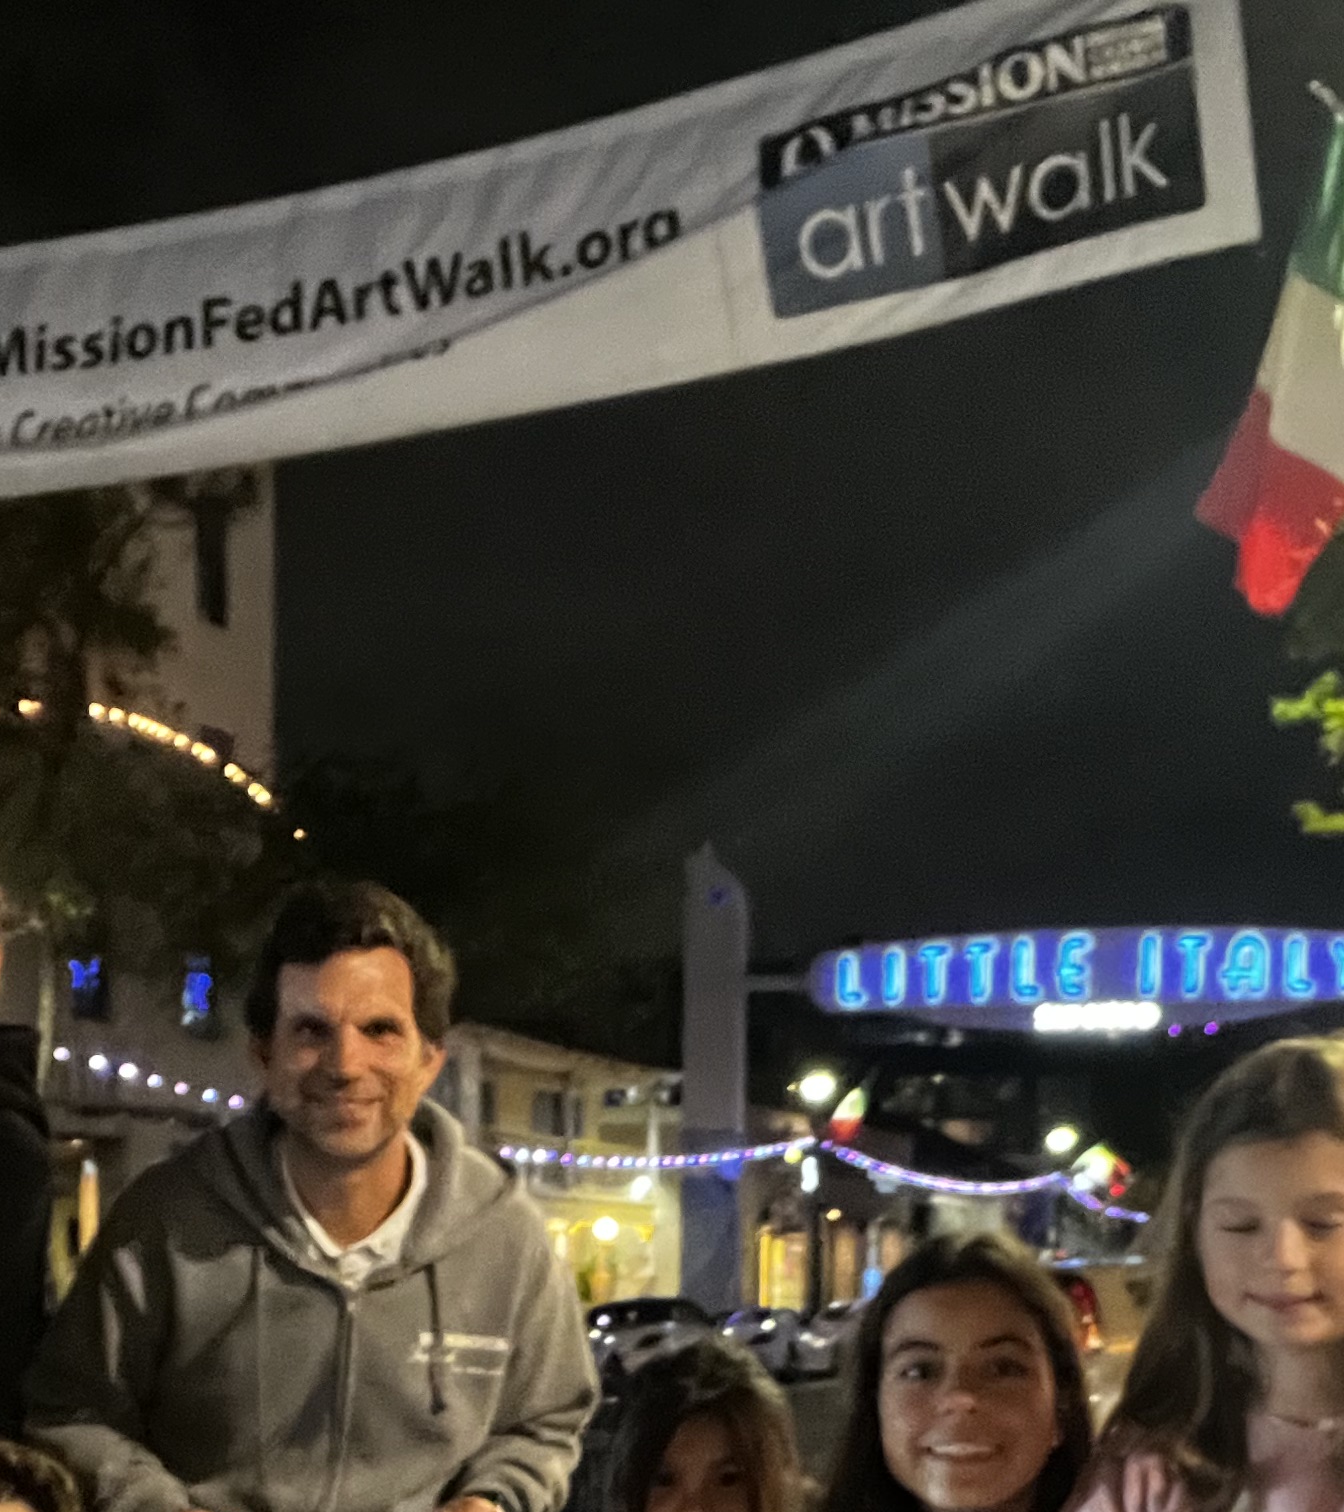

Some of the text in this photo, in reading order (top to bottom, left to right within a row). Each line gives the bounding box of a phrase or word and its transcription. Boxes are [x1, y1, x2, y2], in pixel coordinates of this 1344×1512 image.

[797, 111, 1170, 280] art walk
[835, 931, 1096, 1008] LITTLE
